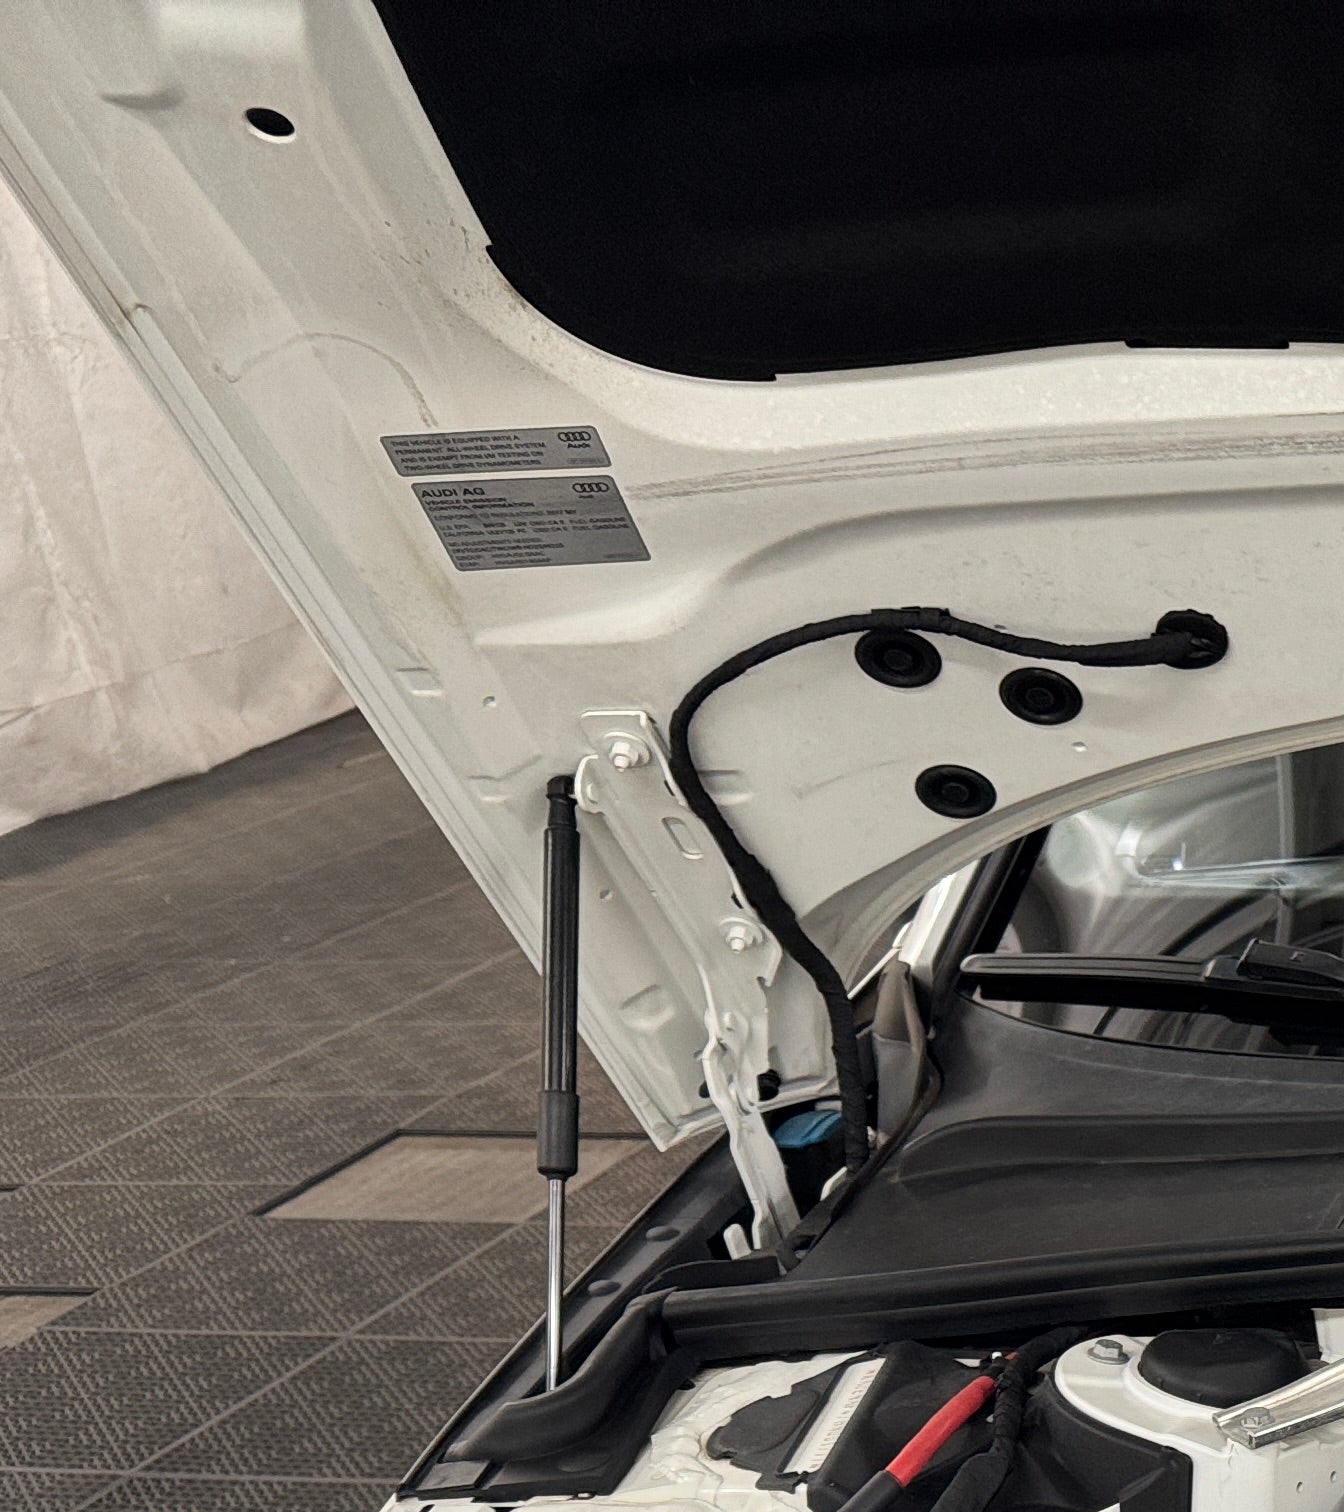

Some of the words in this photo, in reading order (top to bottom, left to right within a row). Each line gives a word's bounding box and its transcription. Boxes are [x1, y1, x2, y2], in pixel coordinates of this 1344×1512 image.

[515, 441, 545, 449] SYSTEM
[419, 488, 457, 498] AUDI
[461, 487, 484, 495] AG
